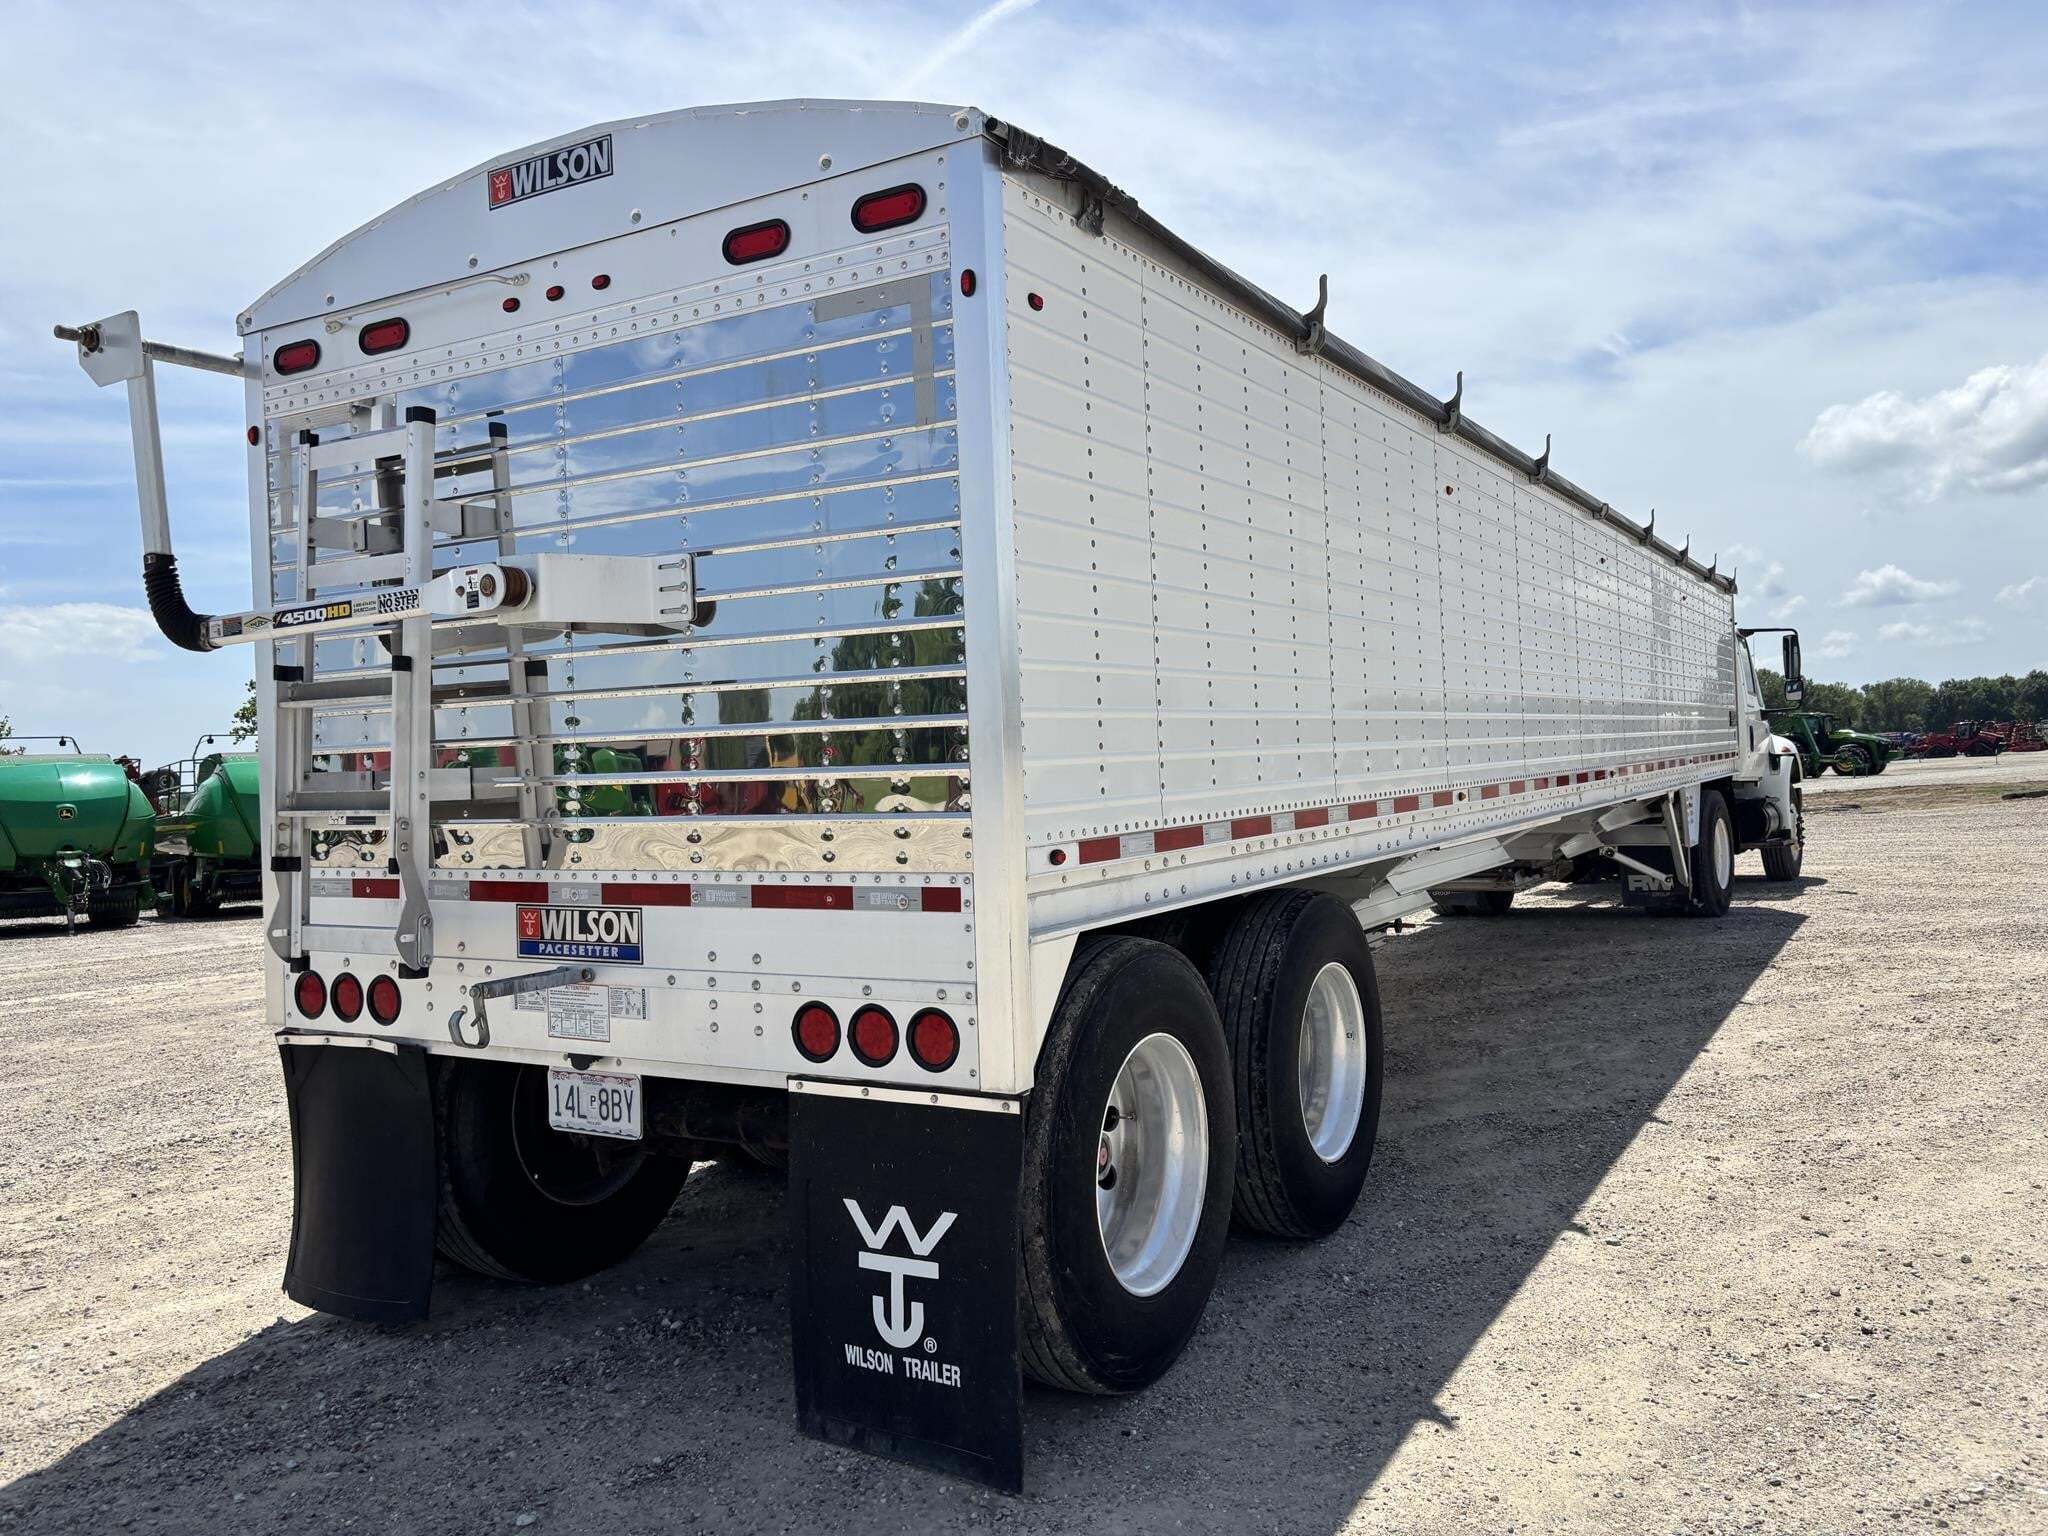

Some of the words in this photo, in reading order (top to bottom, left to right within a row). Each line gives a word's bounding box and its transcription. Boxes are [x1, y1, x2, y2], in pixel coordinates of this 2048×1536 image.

[511, 139, 610, 198] WILSON
[379, 598, 393, 610] NO
[394, 594, 418, 607] STEP
[540, 909, 639, 944] WILSON
[538, 943, 620, 958] PACESETTER
[553, 1084, 588, 1119] 14L
[598, 1088, 634, 1124] 8BY
[844, 1343, 894, 1375] WILSON
[902, 1356, 961, 1388] TRAILER
